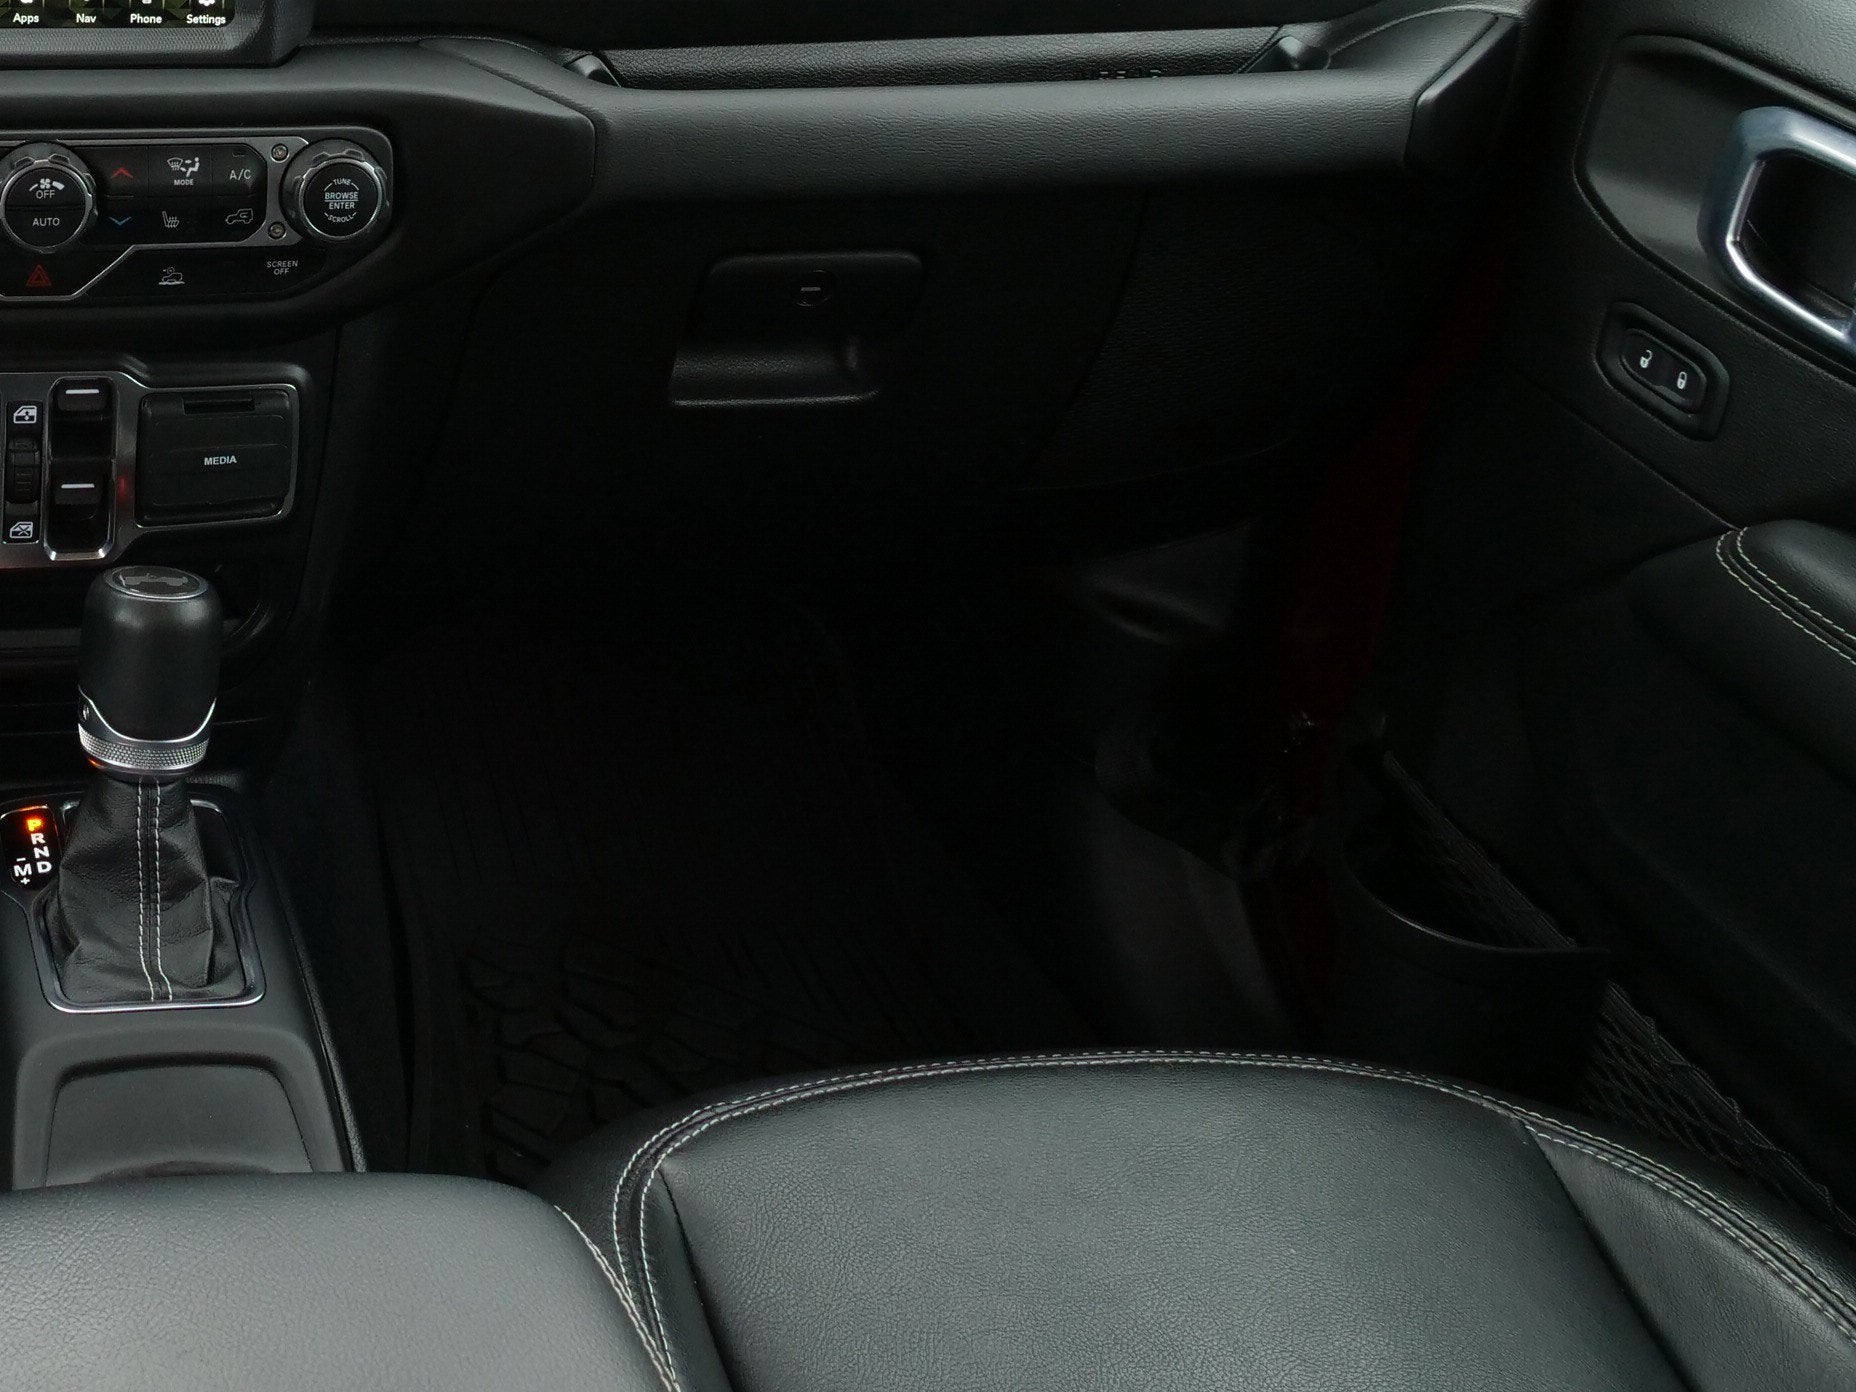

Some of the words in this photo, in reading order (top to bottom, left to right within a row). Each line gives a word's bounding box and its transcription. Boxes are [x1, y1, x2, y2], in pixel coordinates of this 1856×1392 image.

[13, 13, 39, 25] Apps
[76, 14, 96, 23] Nav
[130, 14, 162, 24] Phone
[186, 14, 226, 26] Settings
[229, 169, 252, 181] A/C
[173, 178, 194, 186] MODE
[332, 177, 352, 186] TUNE
[35, 190, 56, 199] OFF
[324, 191, 359, 200] BROWSE
[328, 201, 356, 210] ENTER
[32, 217, 61, 227] AUTO
[327, 214, 354, 224] SCROLL
[266, 260, 299, 269] SCREEN
[273, 268, 290, 276] OFF
[203, 454, 238, 467] MEDIA
[27, 818, 42, 832] P
[30, 832, 46, 845] R
[33, 845, 50, 859] N
[13, 863, 32, 877] M
[36, 861, 52, 874] D
